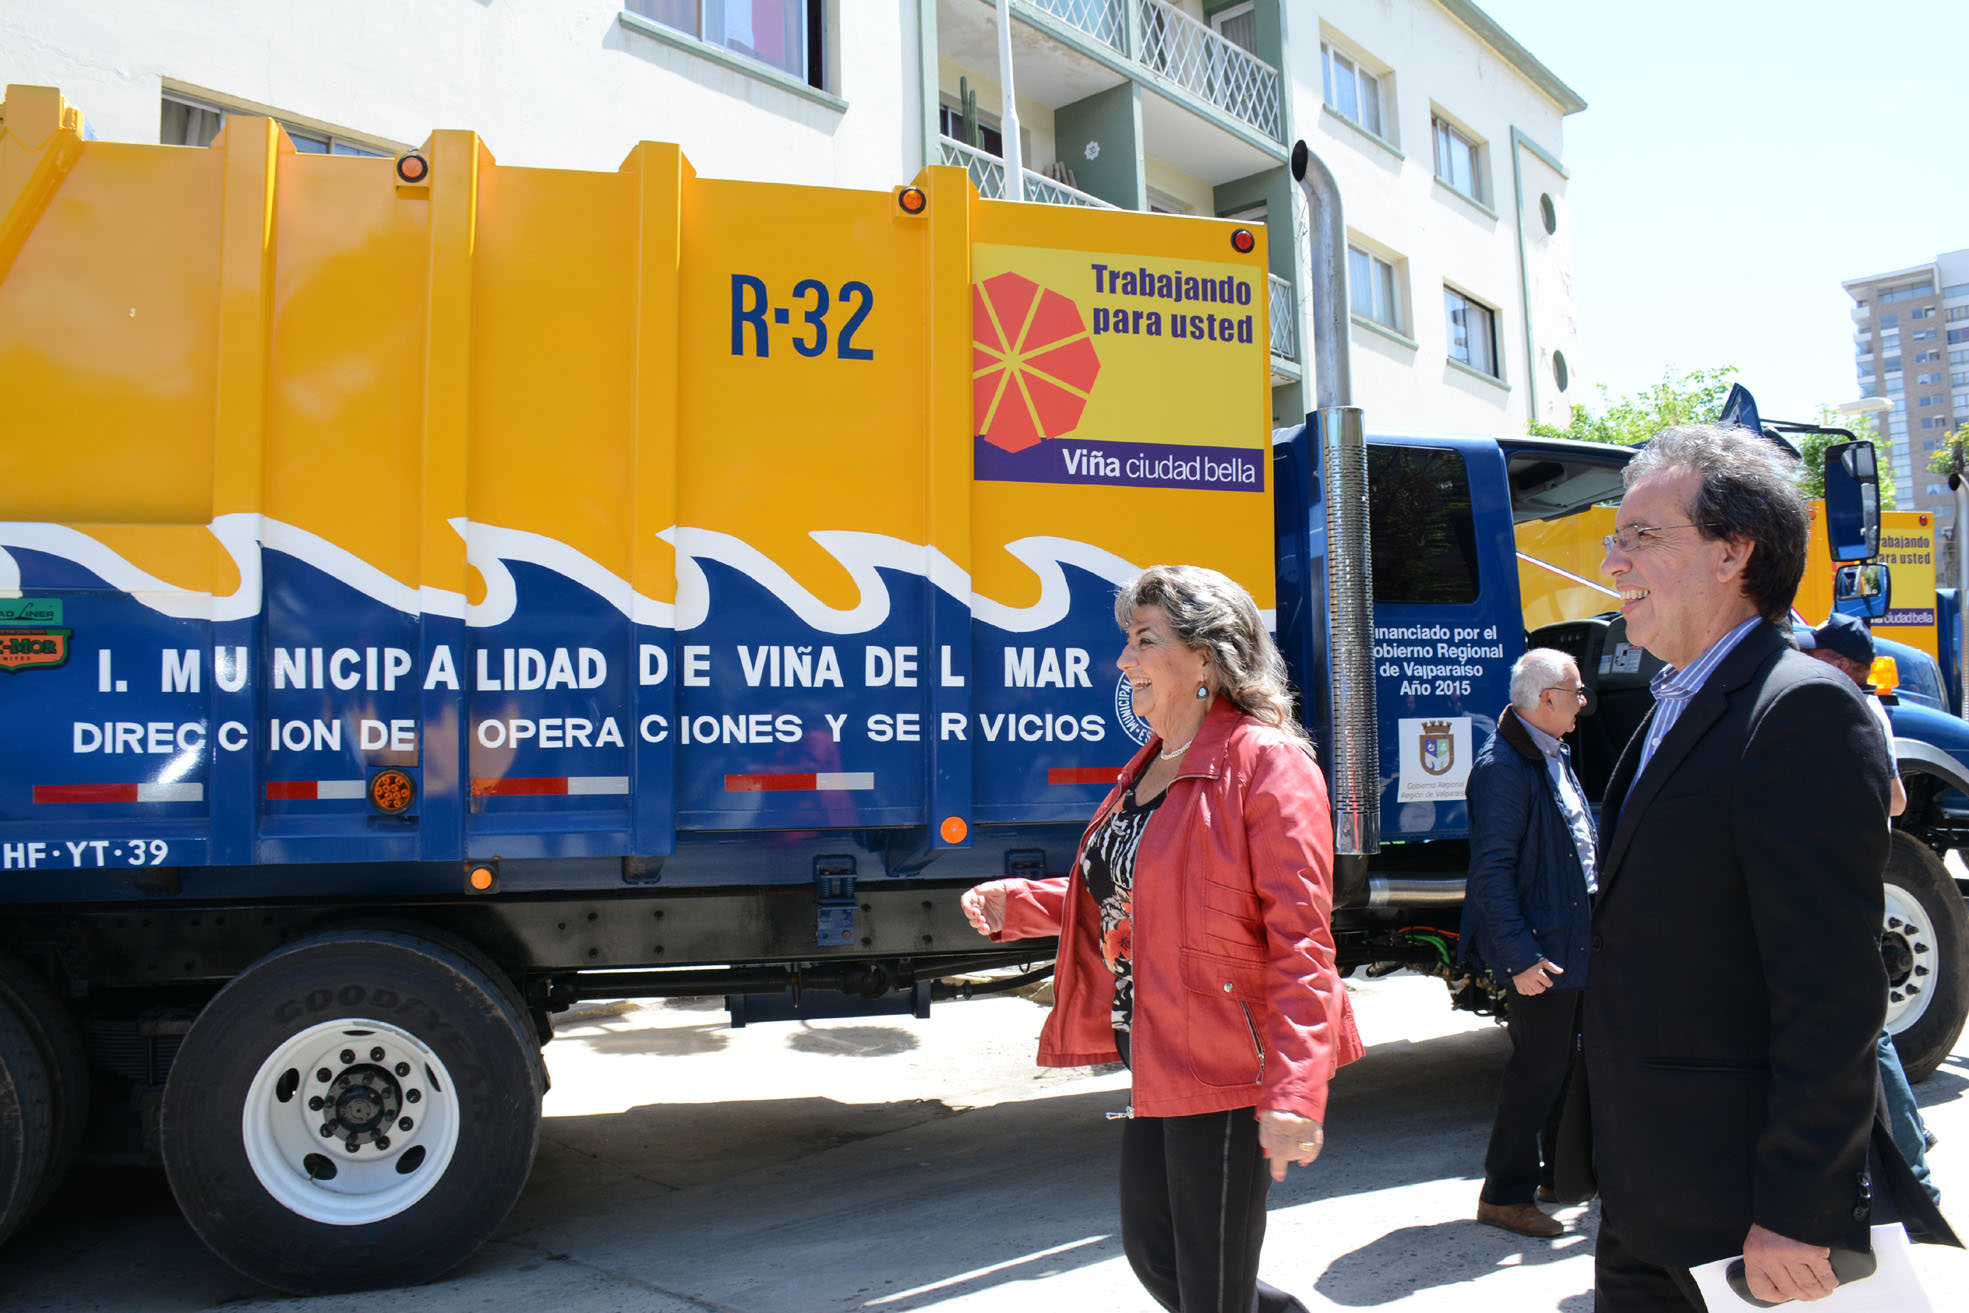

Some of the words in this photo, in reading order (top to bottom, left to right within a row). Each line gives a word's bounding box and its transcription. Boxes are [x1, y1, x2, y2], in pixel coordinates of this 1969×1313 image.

[1091, 263, 1252, 306] Trabajando
[1093, 307, 1162, 336] para
[1171, 312, 1254, 344] usted
[1062, 448, 1121, 477] Viña
[1126, 453, 1200, 481] ciudad
[1204, 456, 1256, 483] bella
[1900, 551, 1931, 565] usted
[1373, 625, 1450, 640] inanciado
[1453, 628, 1480, 643] por
[1483, 625, 1498, 640] el
[1373, 643, 1433, 658] obierno
[1437, 643, 1503, 664] Regional
[98, 648, 128, 693] I.
[161, 645, 607, 693] MUNICIPALIDAD
[639, 643, 711, 688] DE
[737, 645, 844, 688] VIÑA
[865, 645, 965, 688] DEL
[1004, 646, 1093, 689] MAR
[1379, 662, 1400, 677] de
[1403, 660, 1484, 680] Valparaíso
[1400, 681, 1431, 696] Año
[1435, 680, 1471, 696] 2015
[73, 718, 341, 754] DIRECCION
[359, 719, 416, 752] DE
[477, 713, 802, 750] OPERACIONES
[825, 713, 848, 743] Y
[867, 711, 1106, 743] SERVICIOS
